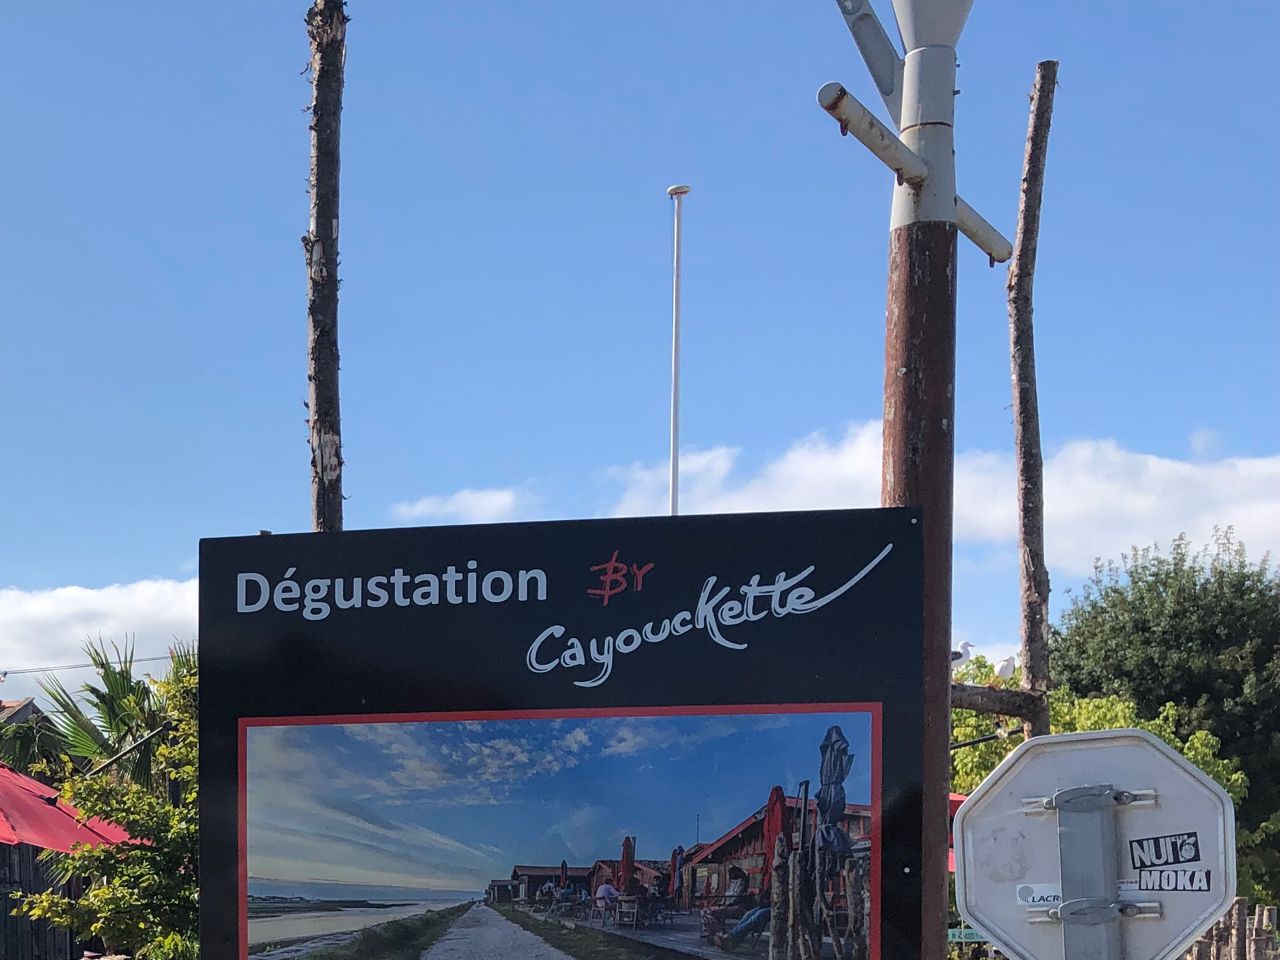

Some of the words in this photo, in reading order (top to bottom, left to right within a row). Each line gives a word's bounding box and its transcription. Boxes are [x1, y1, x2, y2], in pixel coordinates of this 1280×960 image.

[236, 560, 547, 621] Dégustation
[1140, 869, 1209, 891] MOKA
[1031, 894, 1062, 904] LACR
